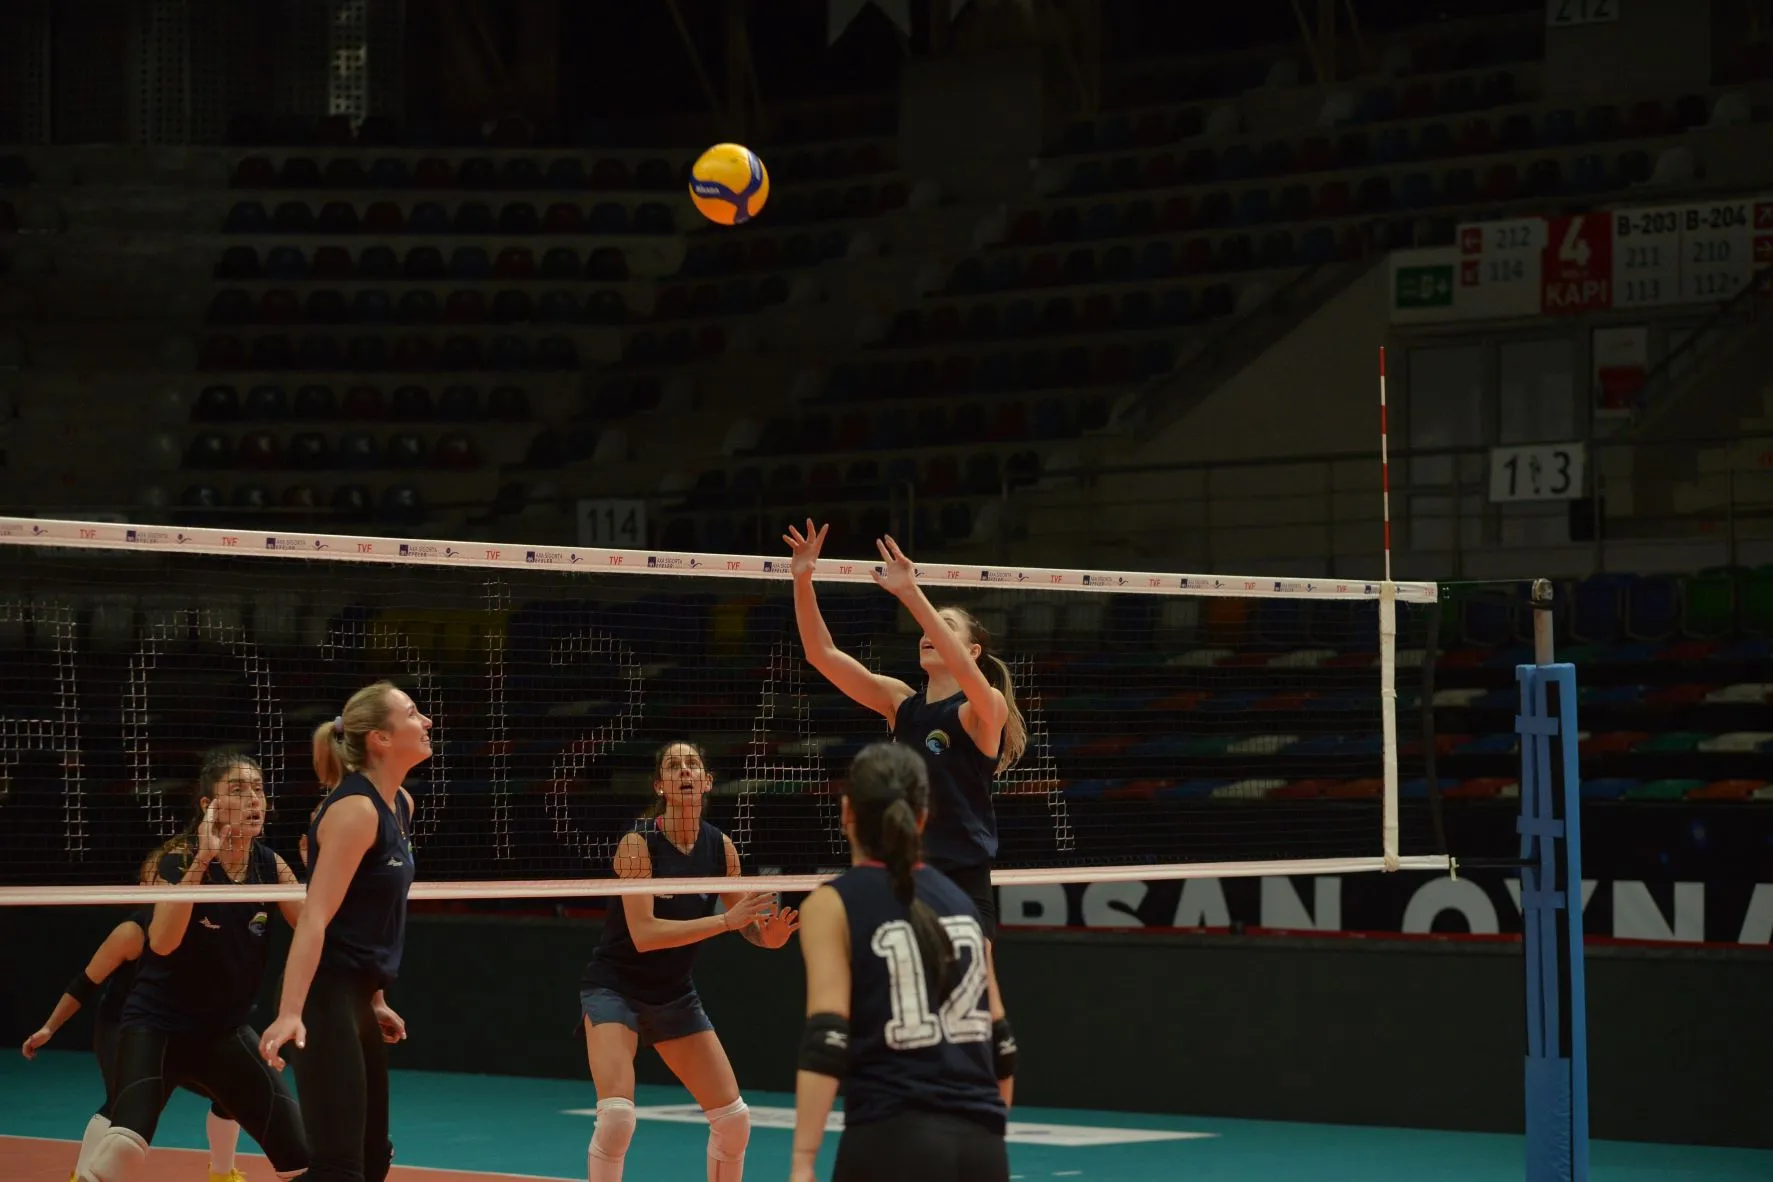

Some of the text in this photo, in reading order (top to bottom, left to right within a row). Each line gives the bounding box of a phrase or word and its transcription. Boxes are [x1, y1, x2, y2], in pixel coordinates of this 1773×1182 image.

[1686, 205, 1746, 230] B-204
[1617, 212, 1677, 236] B-203
[1558, 215, 1592, 266] 4
[1694, 240, 1730, 263] 210
[1546, 278, 1608, 307] KAPI
[587, 507, 637, 542] 114
[80, 529, 96, 539] TVF
[222, 537, 238, 546] TVF
[357, 543, 372, 553] TVF
[486, 551, 500, 560] TVF
[609, 556, 623, 565] TVF
[727, 561, 740, 570] TVF
[839, 566, 853, 575] TVF
[947, 571, 960, 580] TVF
[1051, 575, 1063, 583] TVF
[871, 915, 992, 1050] 12
